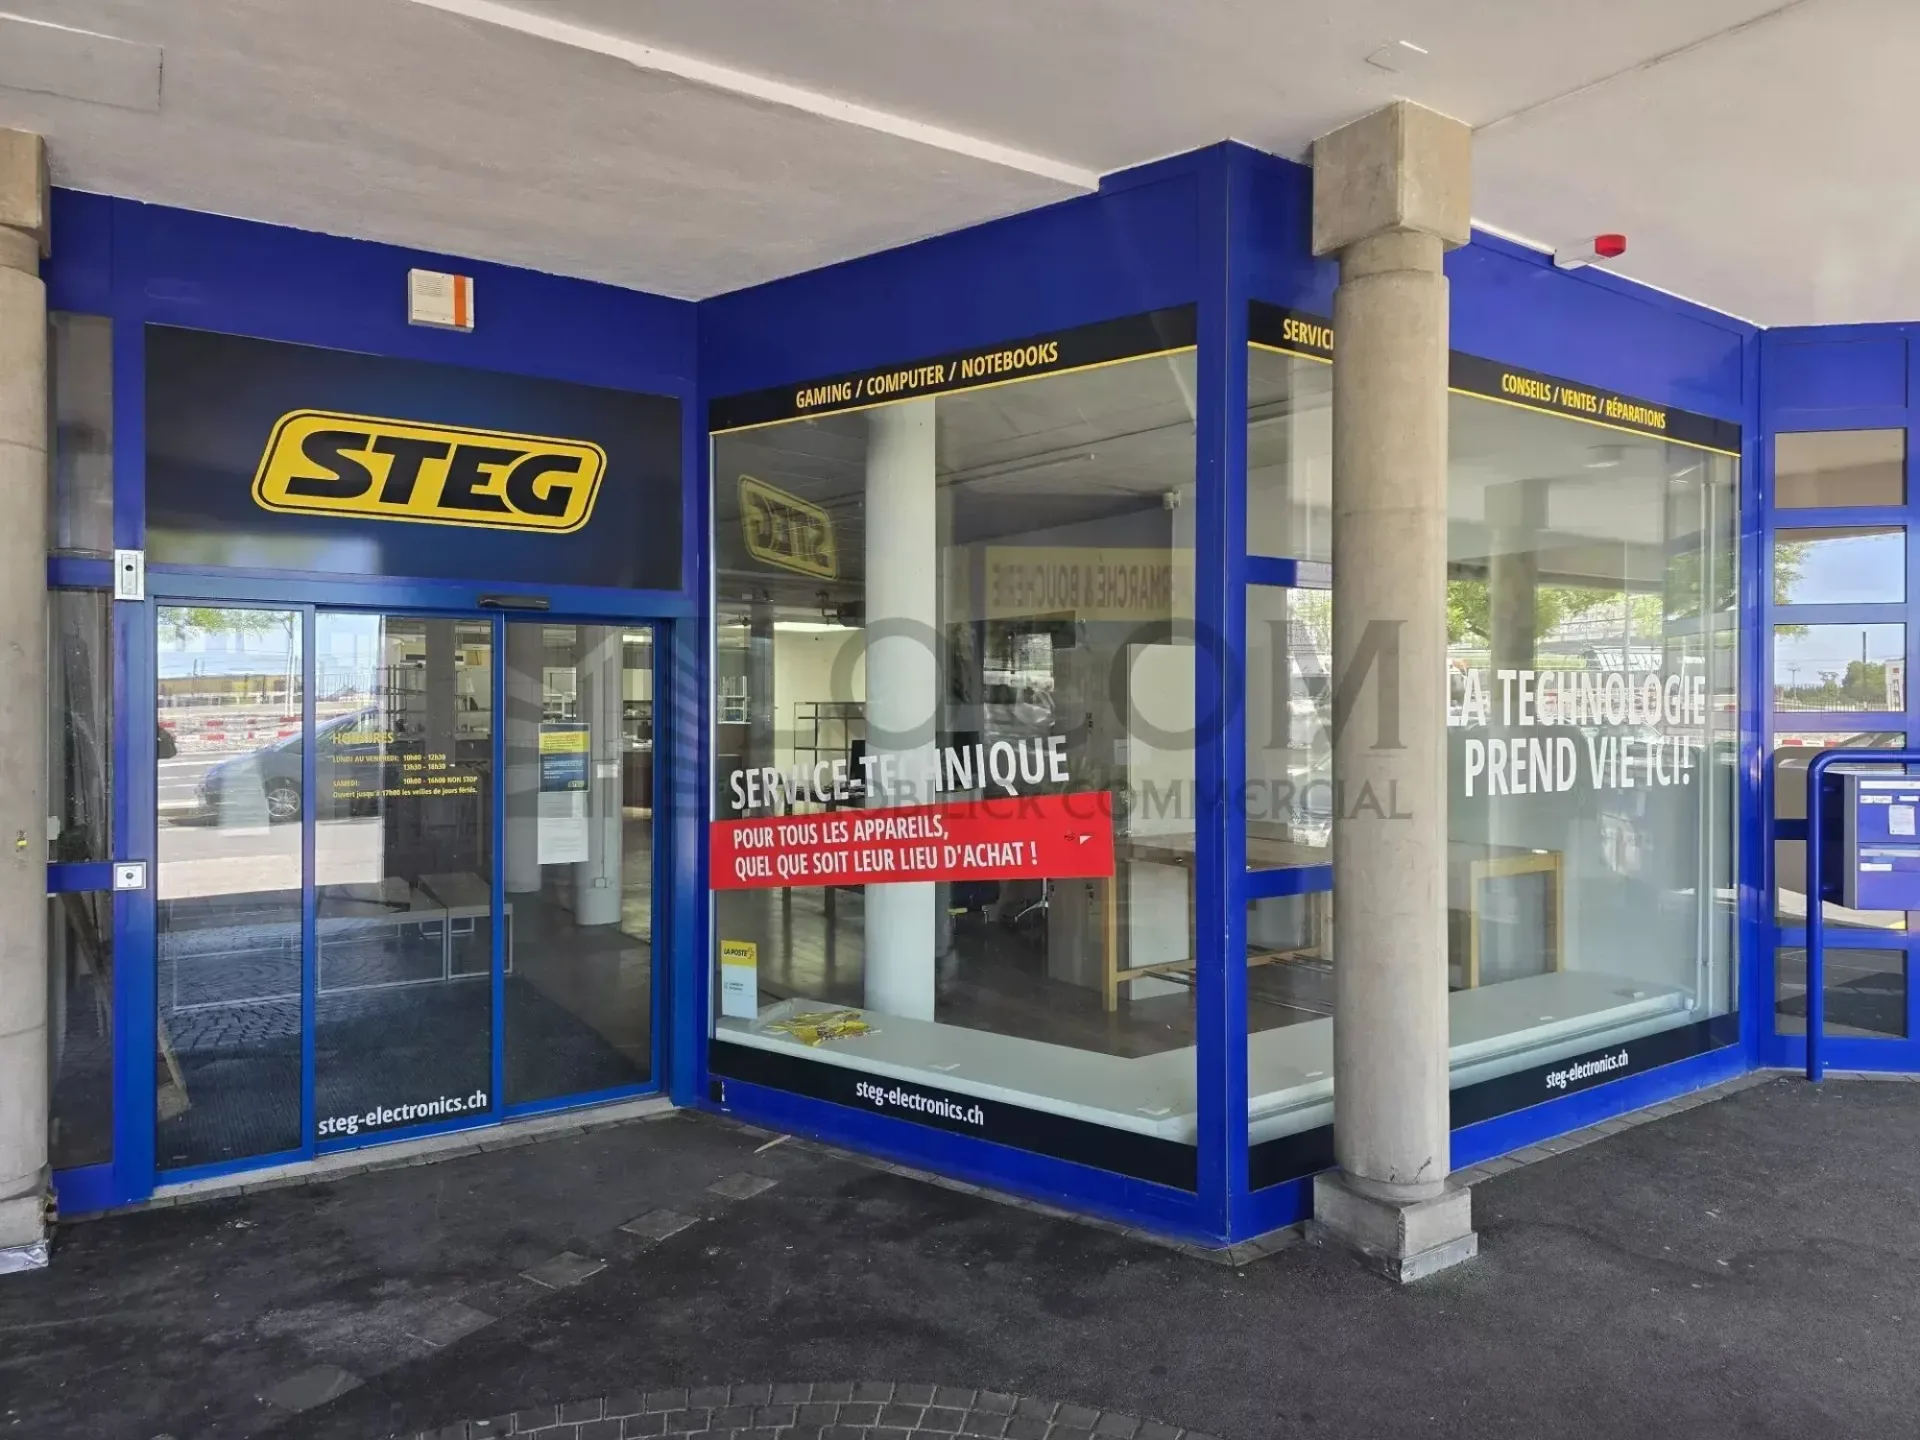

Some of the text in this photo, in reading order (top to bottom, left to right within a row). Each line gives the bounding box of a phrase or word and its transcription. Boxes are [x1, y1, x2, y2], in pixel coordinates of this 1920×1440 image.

[795, 341, 1059, 410] GAMING / COMPUTER / NOTEBOOKS
[1501, 373, 1667, 430] CONSEILS / VENTES / RÉPARATIONS
[284, 429, 584, 518] STEG
[1497, 668, 1706, 727] TECHNOLOGIE
[1465, 734, 1691, 798] PREND VIE ICI!
[733, 814, 949, 849] POUR TOUS LES APPAREILS,
[734, 841, 1038, 882] QUEL QUE SOIT LEUR LIEU D'ACHAT !
[730, 948, 748, 957] POSTE
[1546, 1048, 1629, 1090] steg-electronics.ch
[318, 1089, 488, 1135] steg-electronics.ch
[856, 1081, 984, 1126] steg-electronics.ch
